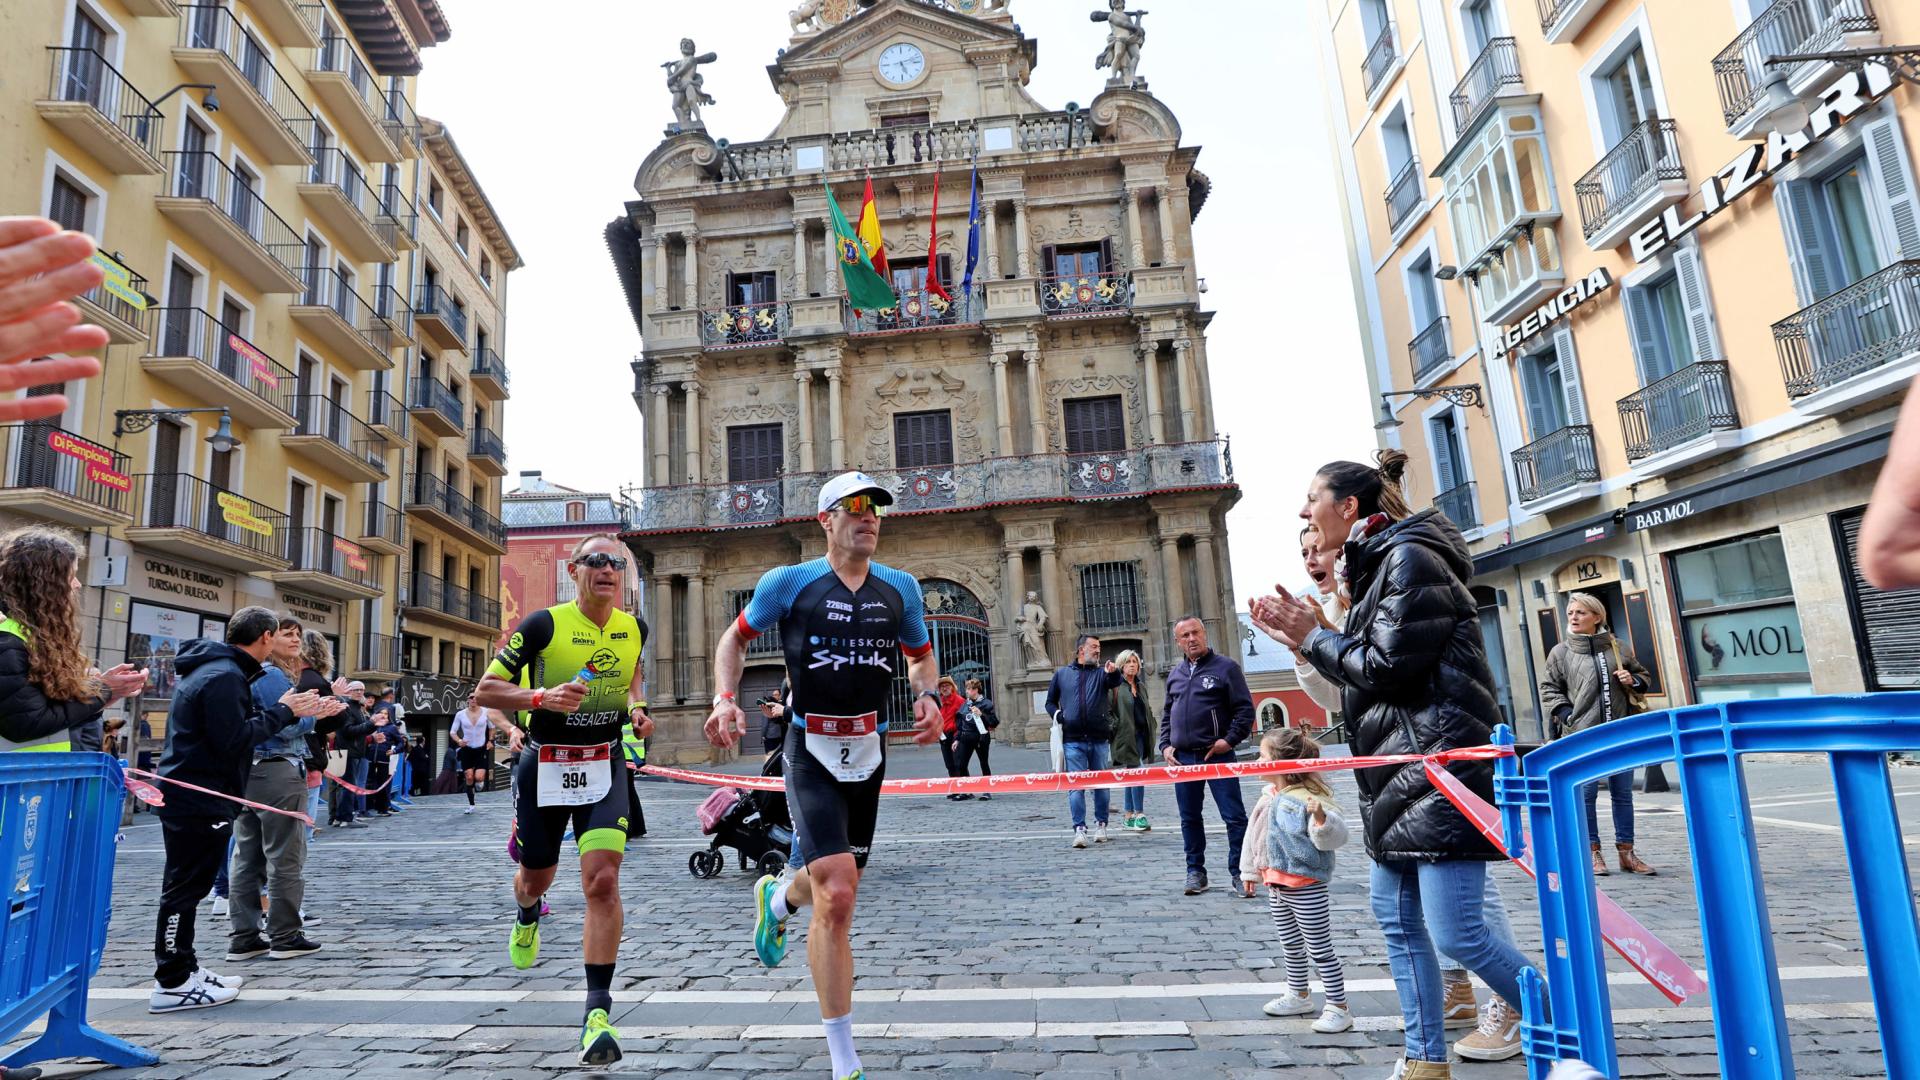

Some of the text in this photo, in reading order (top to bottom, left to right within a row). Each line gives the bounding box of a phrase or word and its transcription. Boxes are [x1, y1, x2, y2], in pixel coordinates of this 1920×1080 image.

[1491, 267, 1609, 359] AGENCIA
[54, 435, 110, 466] Di Pamplona
[1635, 500, 1695, 530] BAR MOL
[144, 560, 224, 589] OFICINA DE TURISMO
[1577, 561, 1600, 580] MOL
[147, 577, 220, 602] TURISMO BULEGOA
[826, 600, 853, 612] 226ERS
[827, 612, 852, 623] BH
[821, 637, 896, 648] TRIESKOLA
[1728, 625, 1804, 658] MOL
[808, 649, 893, 673] Spiuk
[1603, 683, 1610, 691] IS
[1603, 691, 1611, 705] LIFE
[565, 710, 619, 727] ESEAIZETA
[841, 747, 850, 765] 2
[562, 772, 588, 789] 394
[164, 913, 181, 954] Joma
